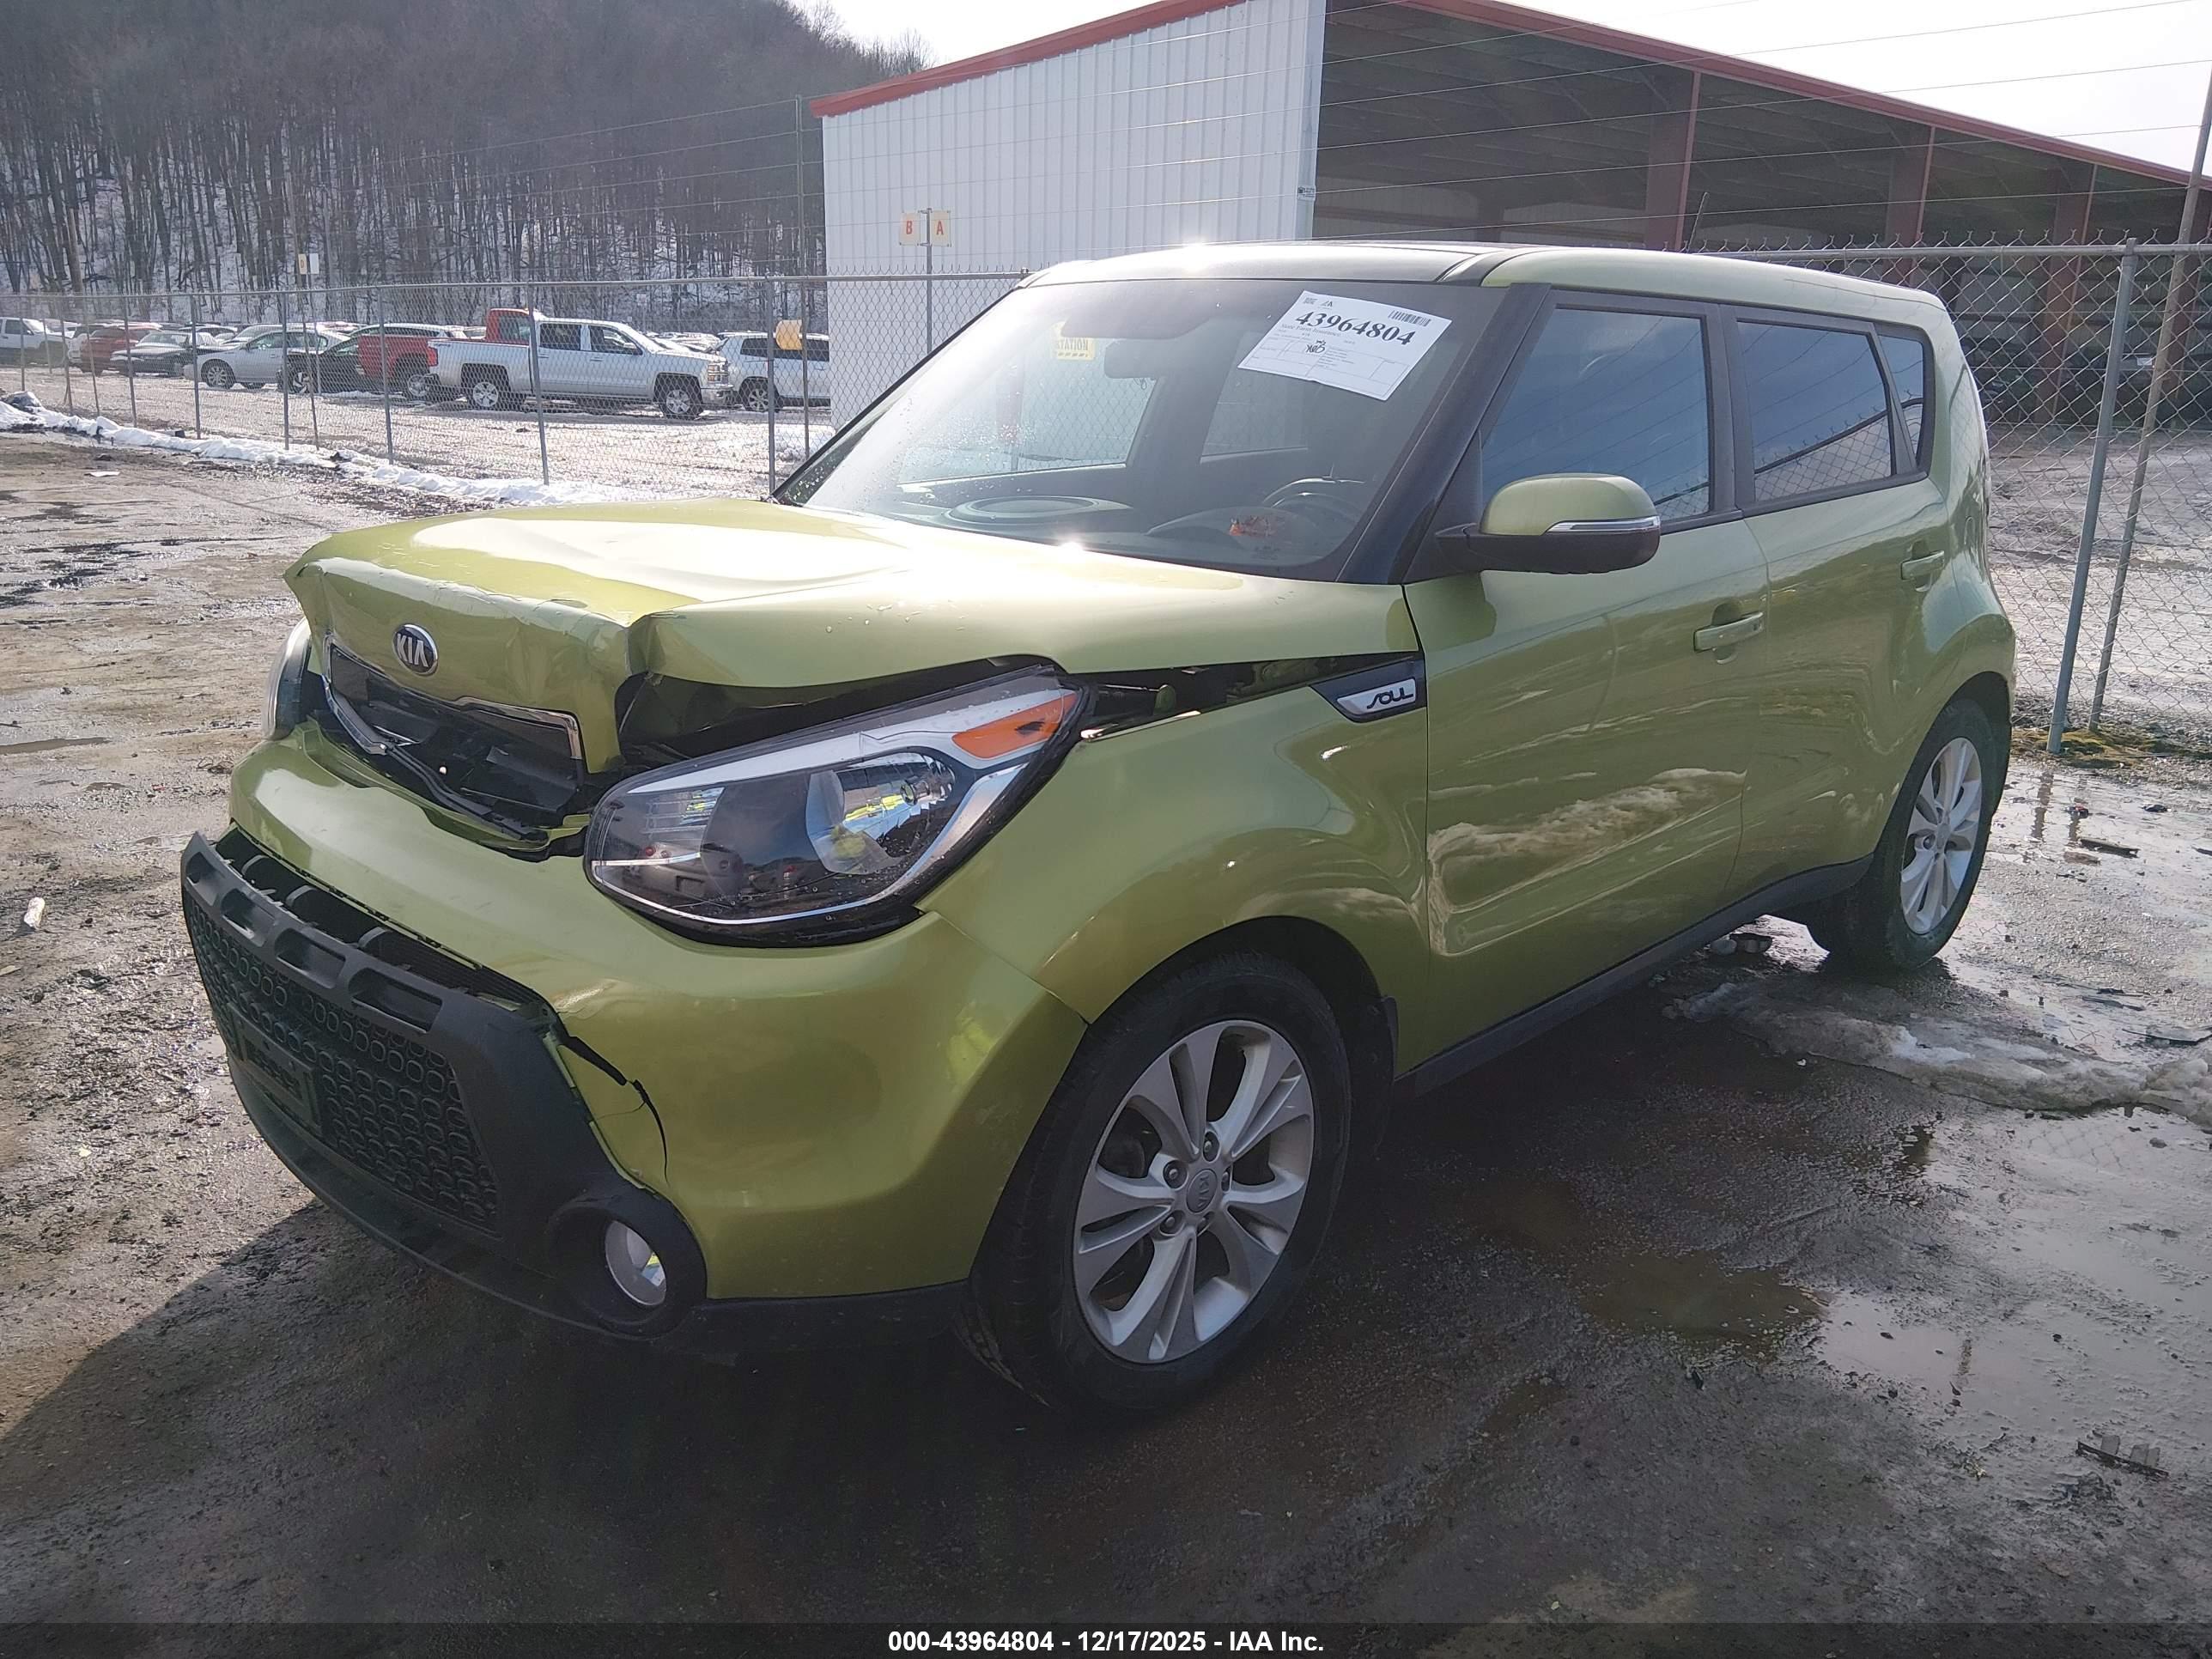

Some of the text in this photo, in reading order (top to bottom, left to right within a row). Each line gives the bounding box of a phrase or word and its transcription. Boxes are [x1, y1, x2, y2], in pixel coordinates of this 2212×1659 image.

[906, 220, 913, 234] B
[936, 221, 944, 235] A
[1296, 310, 1416, 345] 43964804
[397, 633, 428, 667] KIA
